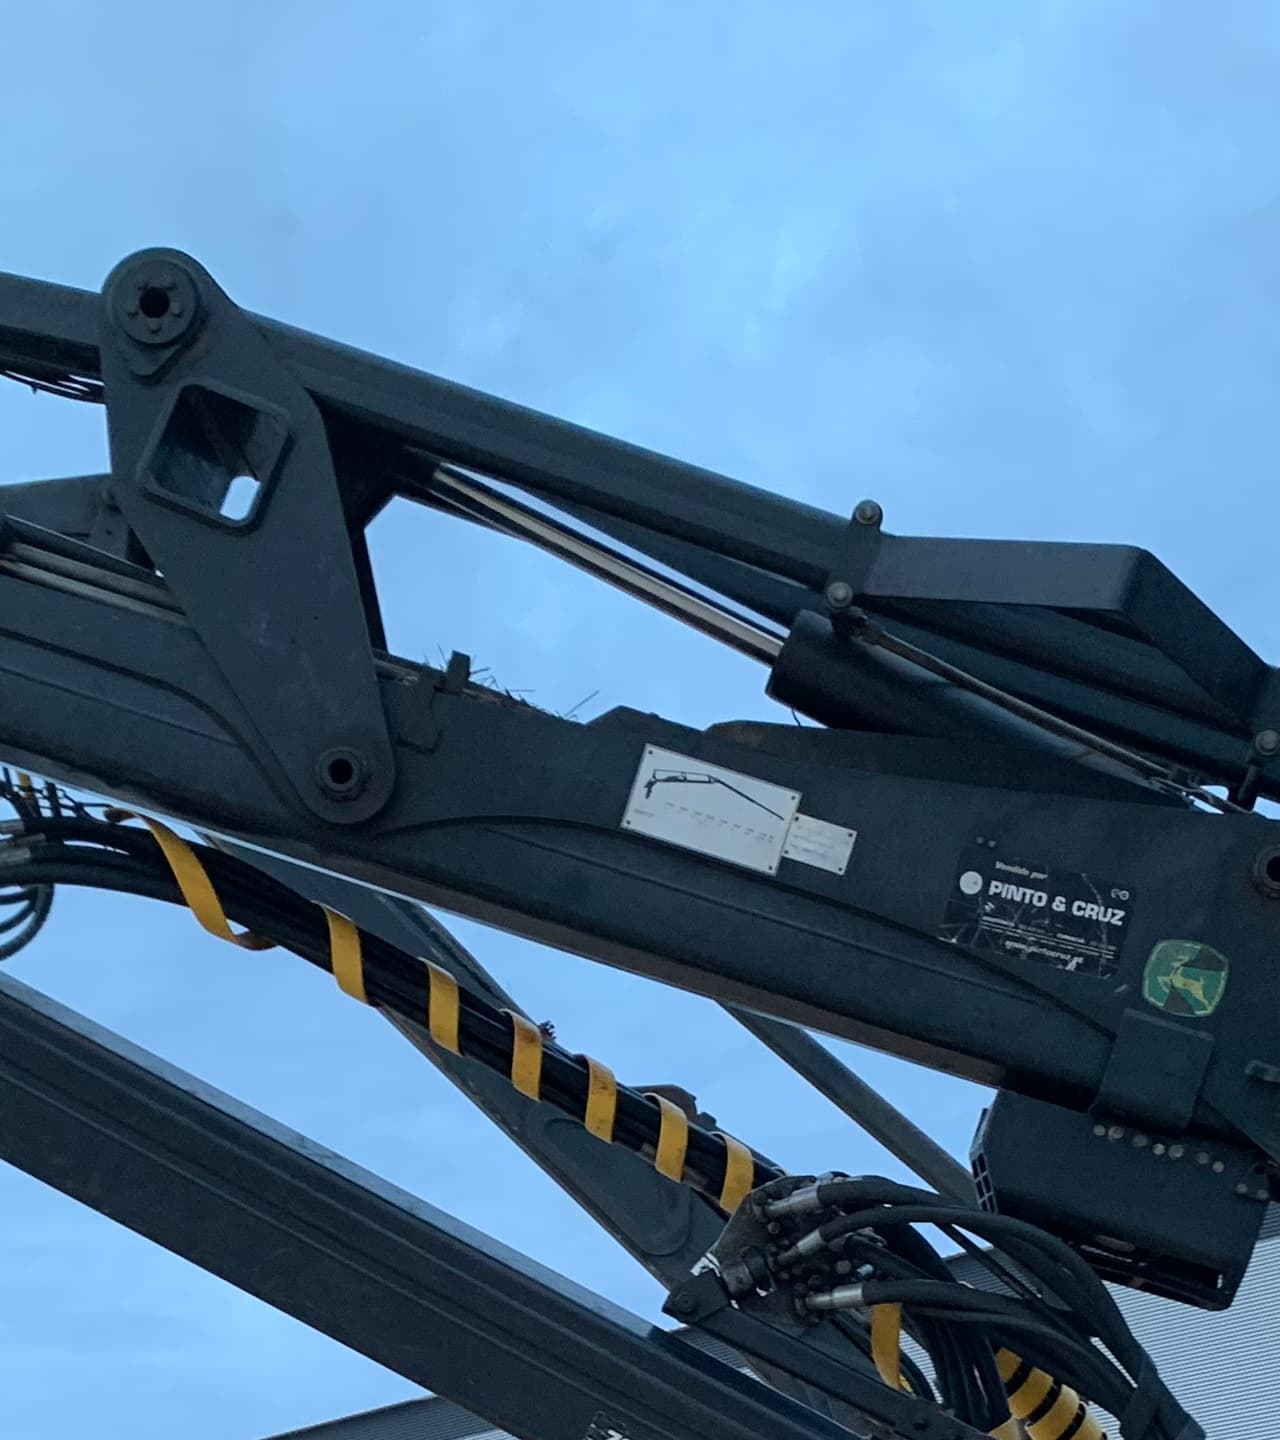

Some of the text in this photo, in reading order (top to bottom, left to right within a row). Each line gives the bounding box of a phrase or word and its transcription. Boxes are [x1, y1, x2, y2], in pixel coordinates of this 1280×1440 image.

[988, 880, 1125, 926] PINTO & CRUZ
